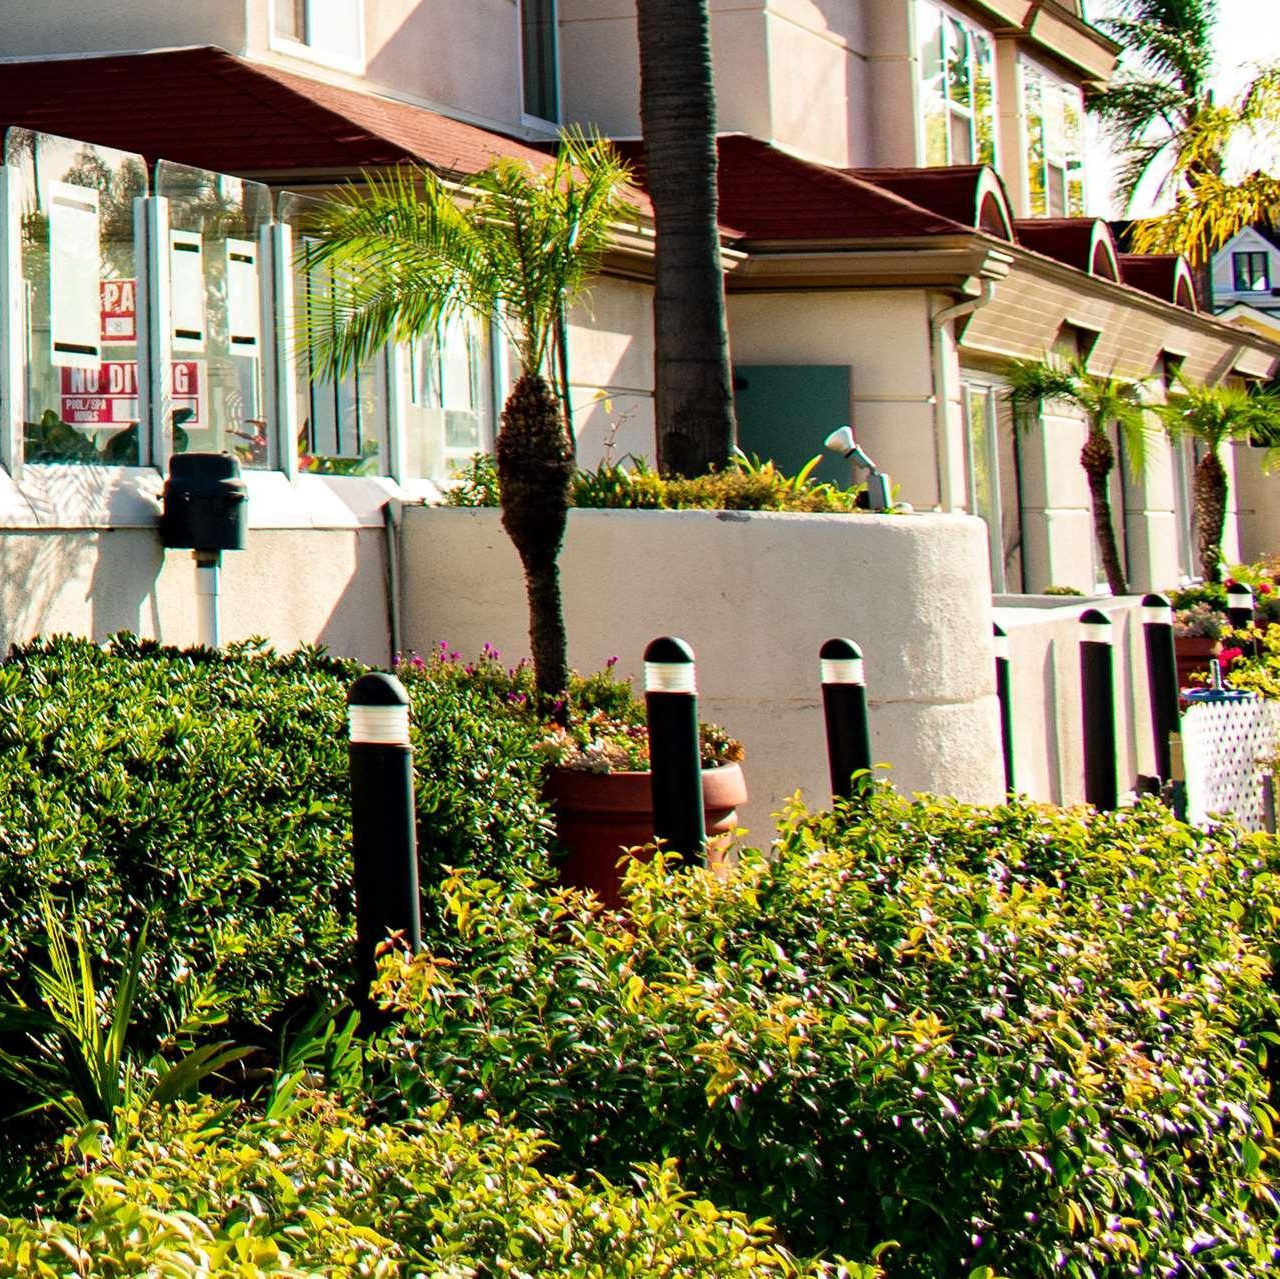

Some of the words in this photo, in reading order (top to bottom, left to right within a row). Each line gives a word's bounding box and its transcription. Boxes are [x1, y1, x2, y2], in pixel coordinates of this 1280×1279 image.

[101, 282, 135, 312] PA
[70, 367, 99, 394] NO
[109, 364, 189, 394] DIG
[65, 399, 107, 410] POOL/SPA
[73, 410, 99, 422] HOURS
